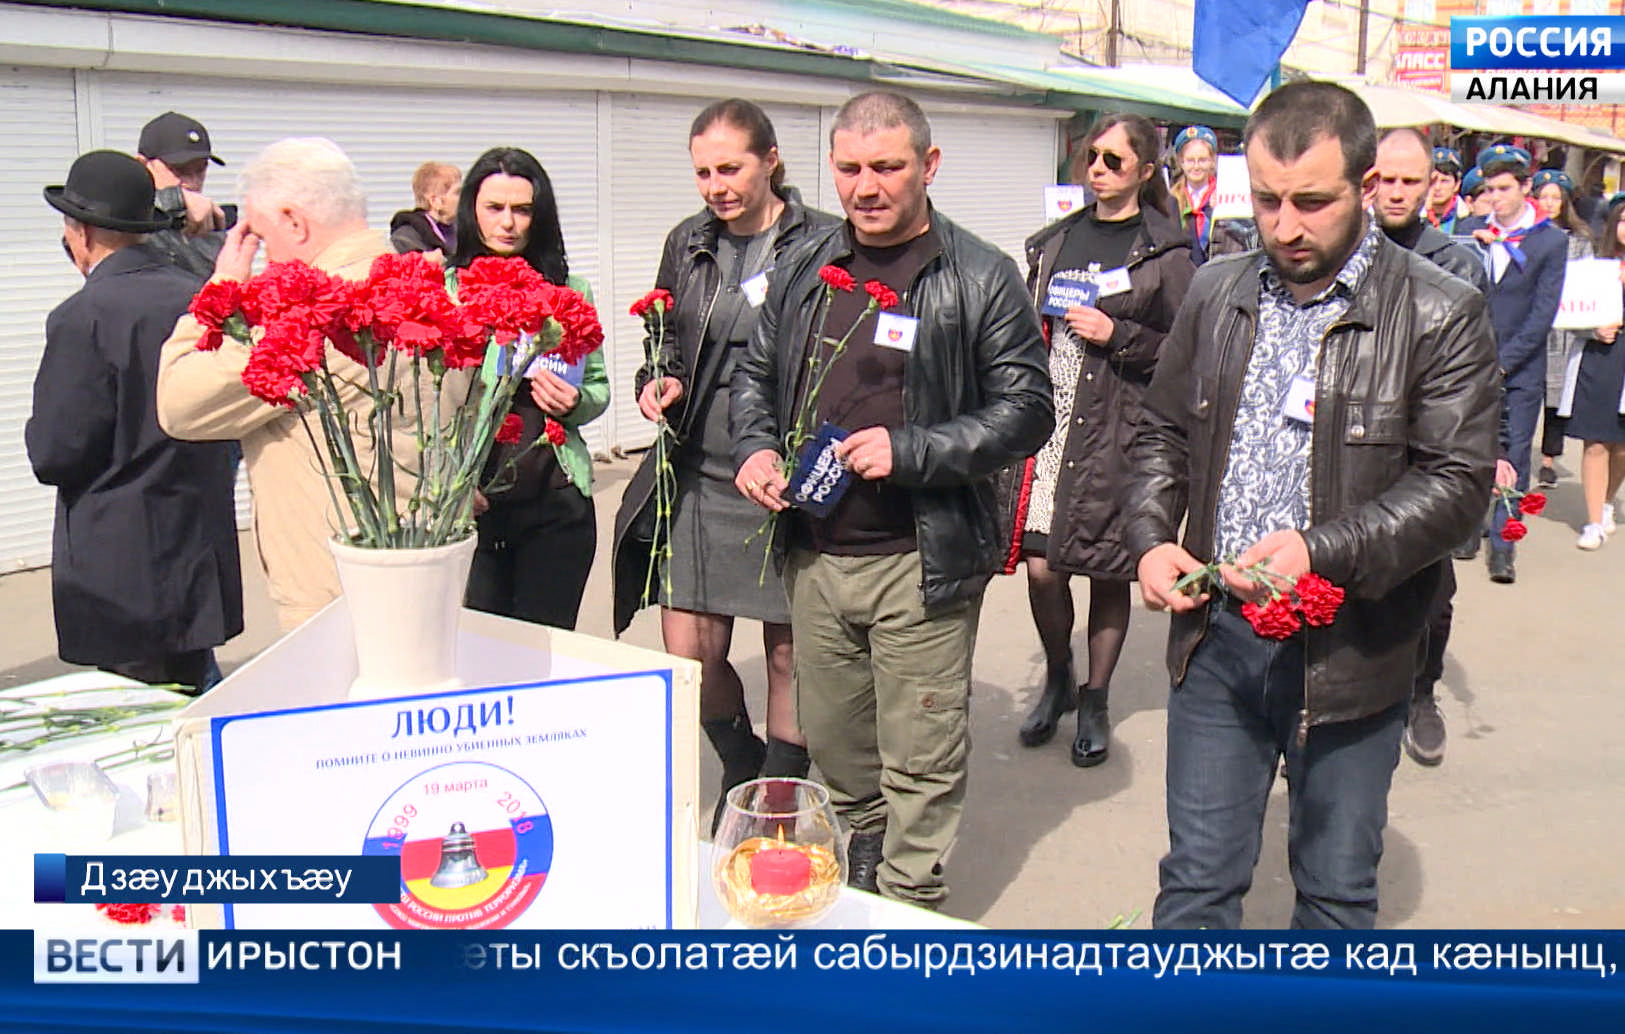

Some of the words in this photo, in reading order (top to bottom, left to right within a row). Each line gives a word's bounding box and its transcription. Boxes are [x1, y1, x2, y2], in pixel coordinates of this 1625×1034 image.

[391, 695, 515, 739] ЛЮДИ!
[316, 752, 378, 769] ПОМНИТЕ
[381, 750, 391, 762] О
[394, 744, 453, 760] НЕВИННО
[456, 737, 521, 753] УБИЕННЫХ
[525, 728, 588, 746] ЗЕМЛЯКАХ
[424, 781, 440, 795] 19
[444, 778, 488, 794] марта
[382, 803, 418, 850] 1999
[497, 791, 534, 835] 2018
